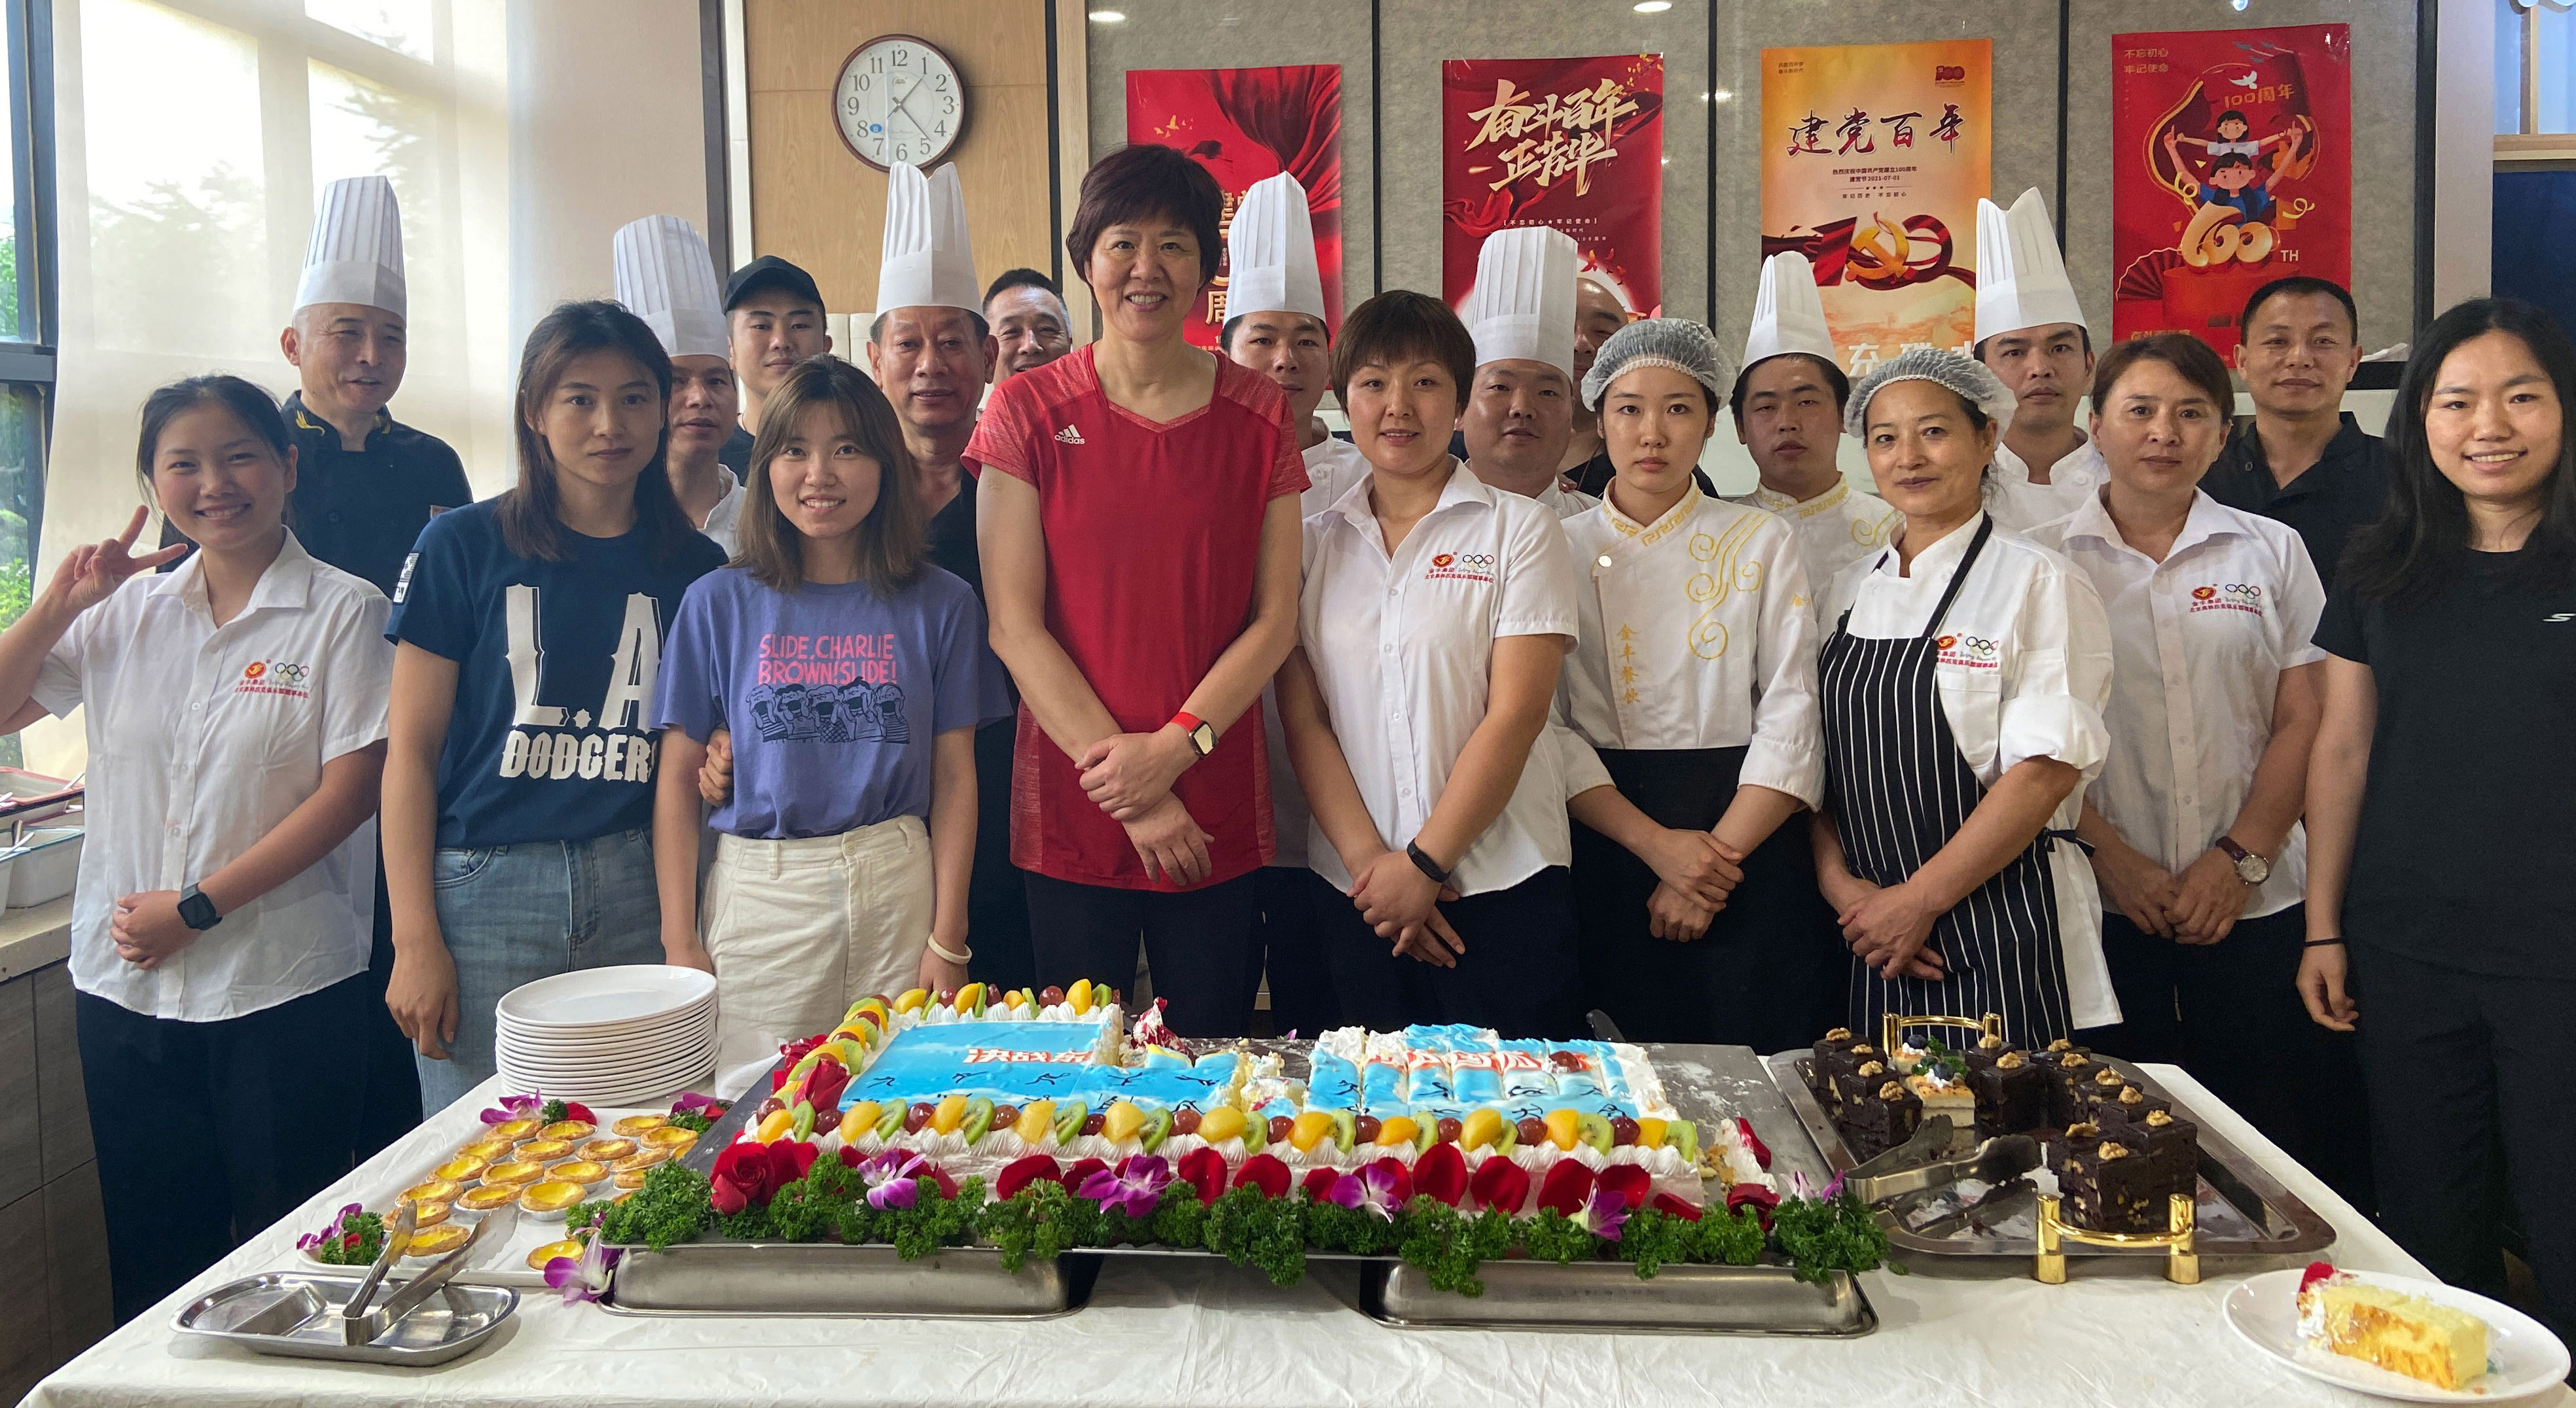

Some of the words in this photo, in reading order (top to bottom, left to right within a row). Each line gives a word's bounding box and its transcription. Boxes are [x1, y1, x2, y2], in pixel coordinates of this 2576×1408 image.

[892, 49, 908, 67] 12
[2124, 48, 2169, 59] 不忘初心
[870, 57, 883, 74] 11
[921, 56, 927, 75] 1
[2124, 63, 2169, 74] 牢记使命
[853, 74, 870, 92] 10
[935, 74, 947, 92] 2
[942, 96, 955, 114] 3
[2225, 83, 2295, 109] 100周年
[847, 97, 859, 115] 9
[1464, 78, 1639, 154] 奋斗百年
[857, 120, 868, 137] 8
[934, 120, 946, 137] 4
[1787, 103, 1965, 157] 建党百年
[873, 138, 884, 156] 7
[895, 143, 908, 161] 6
[920, 138, 931, 155] 5
[2280, 249, 2299, 262] TH
[1054, 434, 1085, 444] adidas
[499, 730, 658, 784] DODGER
